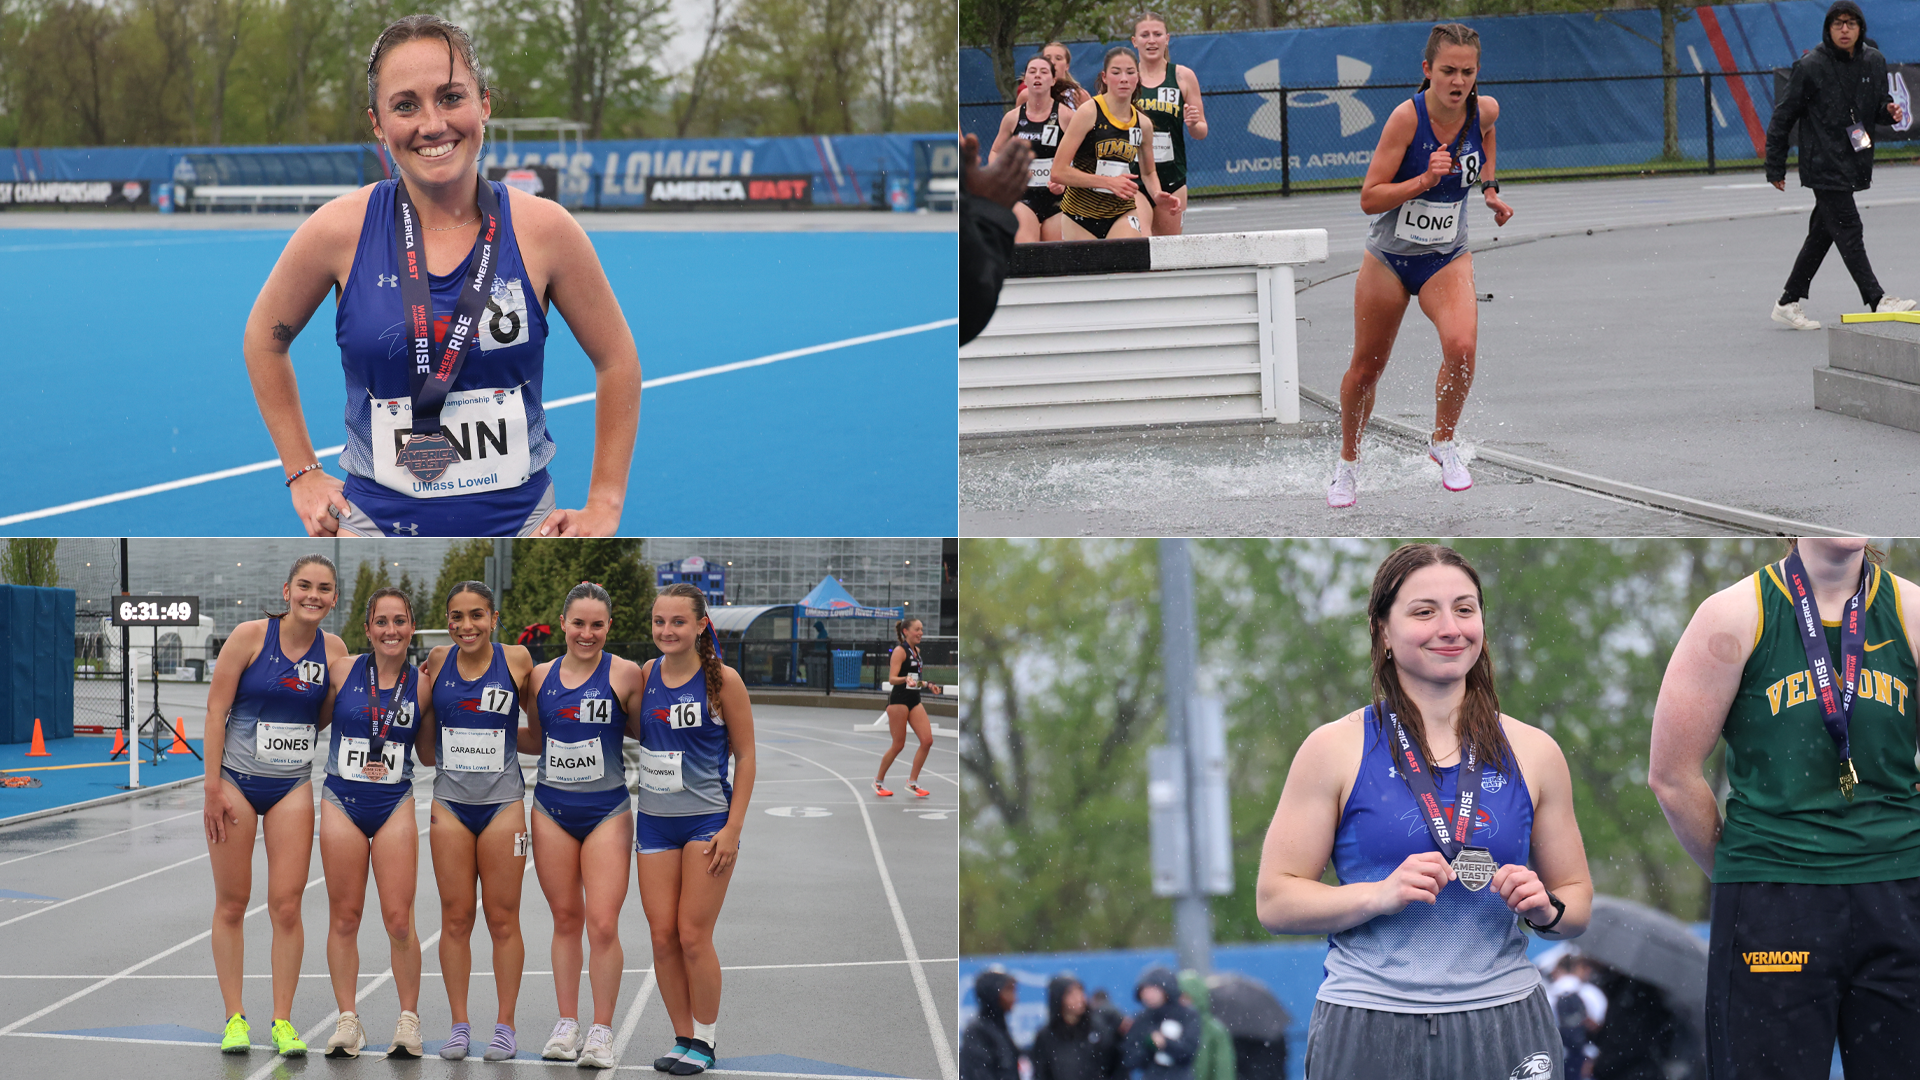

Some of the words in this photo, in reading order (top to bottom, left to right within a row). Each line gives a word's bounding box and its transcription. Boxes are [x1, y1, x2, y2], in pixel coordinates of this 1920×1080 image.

[1162, 89, 1176, 103] 13
[1046, 126, 1055, 144] 7
[1226, 155, 1300, 173] UNDER
[1307, 150, 1374, 168] ARMO
[1466, 155, 1477, 184] 8
[14, 181, 113, 202] CHAMPIONSHIP
[651, 180, 745, 201] AMERICA
[748, 179, 808, 200] EAST
[401, 203, 414, 249] AMERICA
[1405, 211, 1454, 230] LONG
[472, 244, 492, 292] AMERICA
[484, 213, 496, 243] EAST
[406, 251, 419, 280] EAST
[416, 304, 428, 338] WHERE
[448, 313, 472, 351] RISE
[415, 337, 430, 374] RISE
[435, 347, 454, 380] WHERE
[394, 418, 508, 463] FNN
[400, 449, 457, 463] AMERICA
[412, 461, 444, 470] EAST
[412, 481, 454, 493] UMass
[458, 473, 498, 488] Lowell
[1792, 573, 1806, 597] EAST
[120, 602, 191, 620] 6:31:49
[805, 607, 828, 617] UMass
[830, 607, 854, 617] Lowell
[1801, 596, 1816, 637] AMERICA
[1849, 610, 1858, 635] EAST
[303, 662, 322, 684] 12
[1814, 657, 1830, 688] RISE
[1849, 655, 1857, 683] WHERE
[487, 689, 508, 712] 17
[1820, 686, 1833, 715] WHERE
[1844, 681, 1854, 711] RISE
[384, 710, 394, 726] RISE
[586, 700, 608, 722] 14
[674, 703, 695, 727] 16
[264, 738, 309, 751] JONES
[450, 746, 496, 755] CARABALLO
[550, 755, 596, 769] EAGAN
[1404, 750, 1421, 774] EAST
[1425, 792, 1442, 818] WHERE
[1459, 790, 1473, 817] RISE
[1431, 817, 1452, 844] RISE
[1454, 815, 1465, 842] WHERE
[1453, 862, 1498, 872] AMERICA
[1461, 872, 1488, 880] EAST
[1742, 951, 1811, 965] VERMONT
